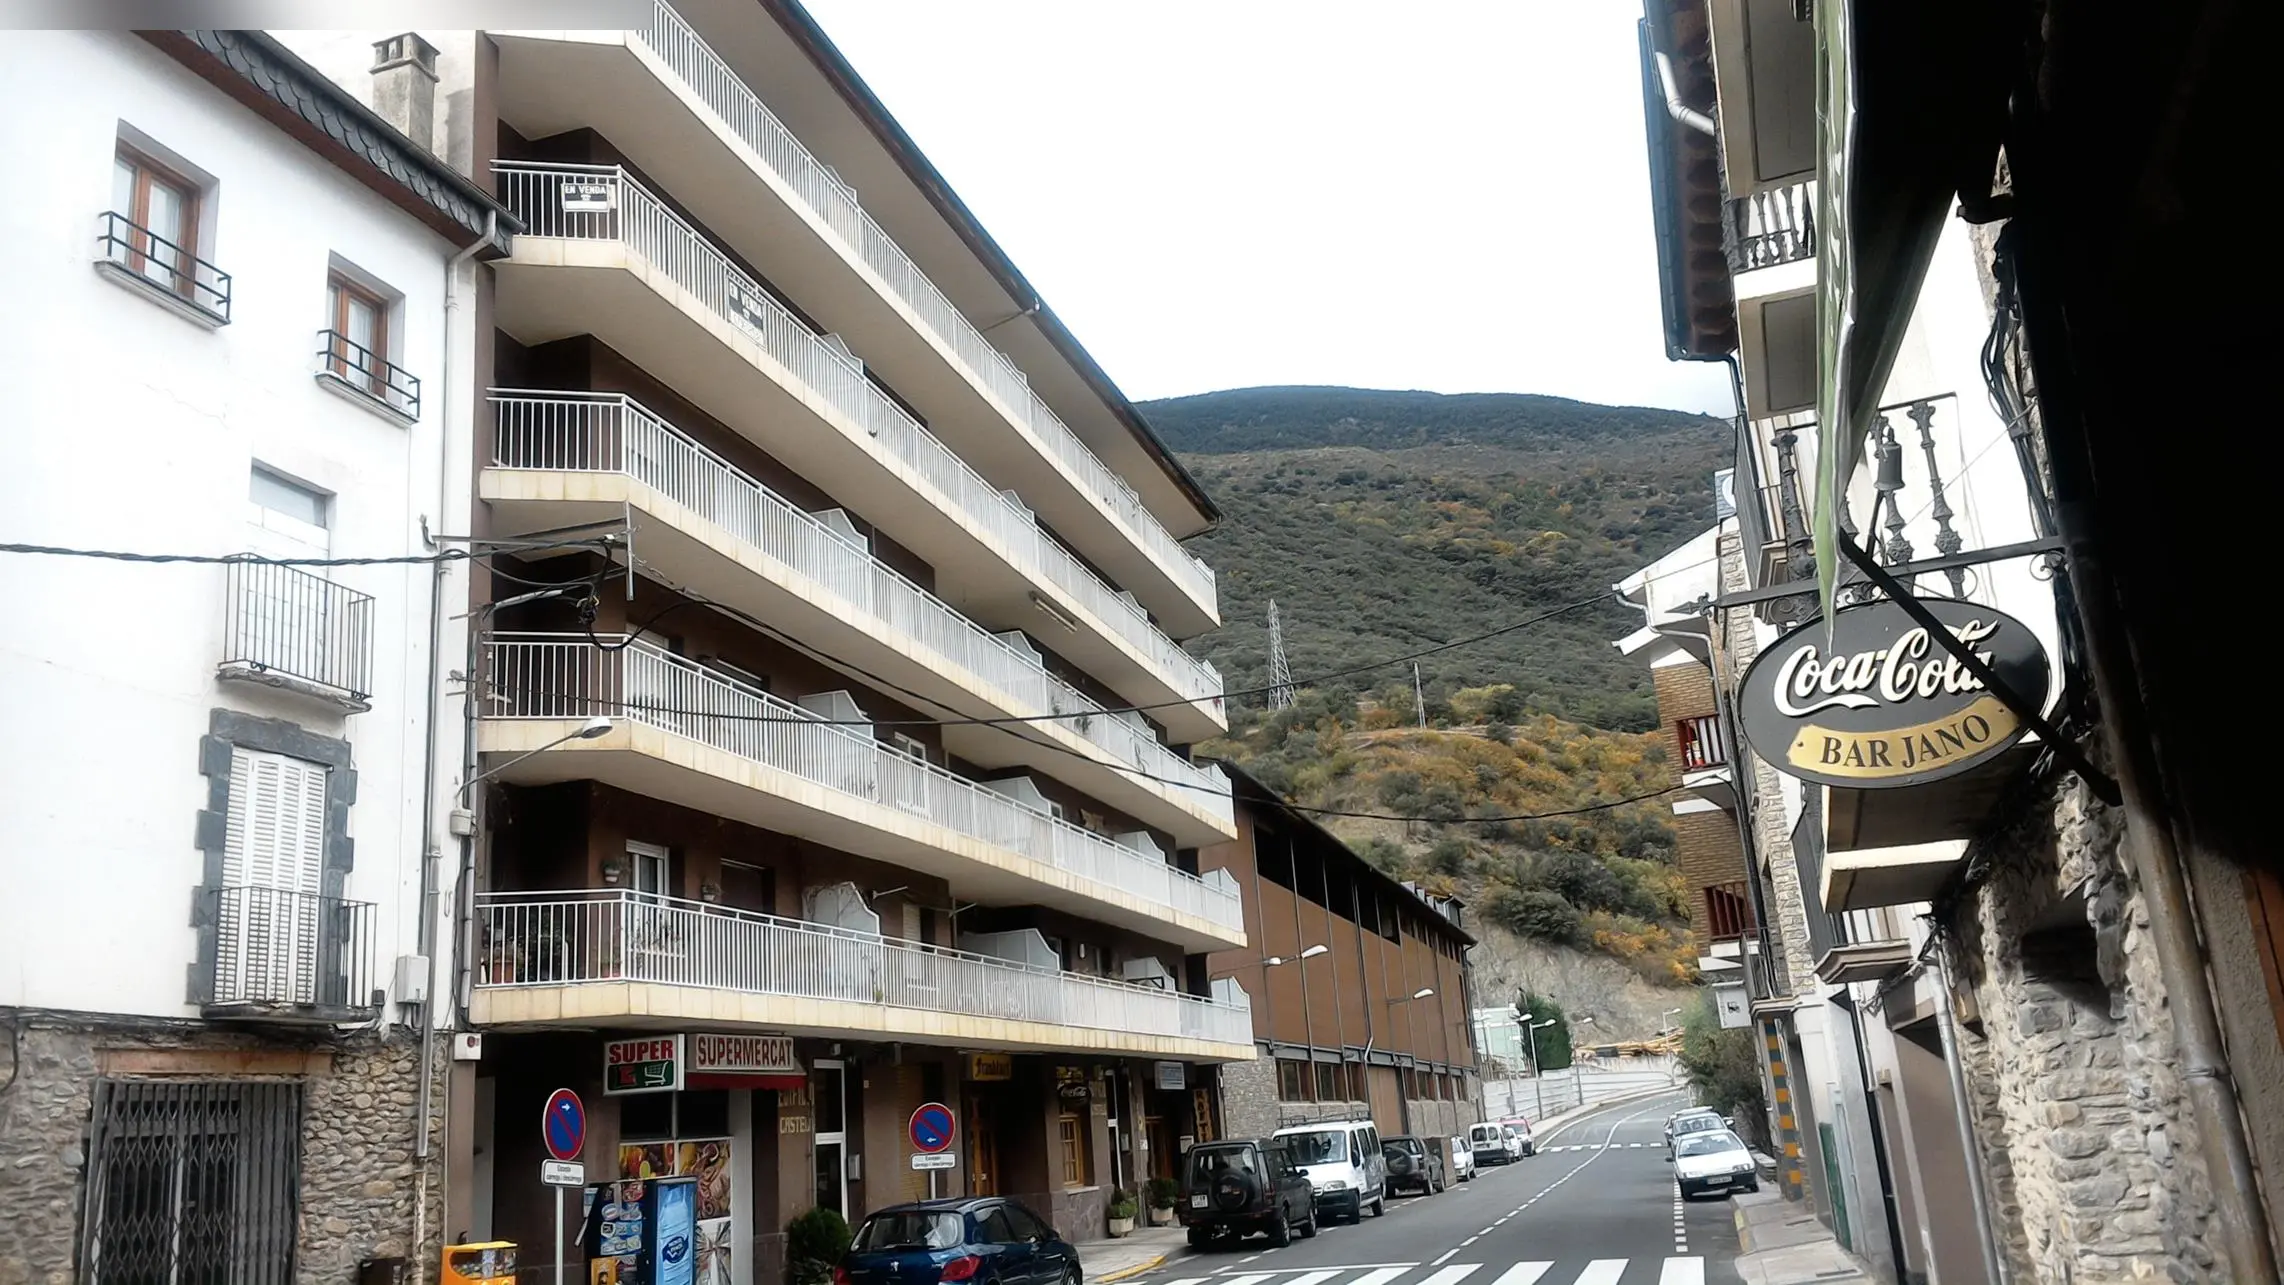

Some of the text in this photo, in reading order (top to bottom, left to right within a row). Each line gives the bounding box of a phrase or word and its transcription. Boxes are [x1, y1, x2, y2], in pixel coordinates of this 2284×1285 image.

[565, 185, 606, 194] EN VENDA
[1820, 714, 1990, 769] BAR JANO
[608, 1039, 673, 1065] SUPER
[697, 1036, 792, 1066] SUPERMERCAT
